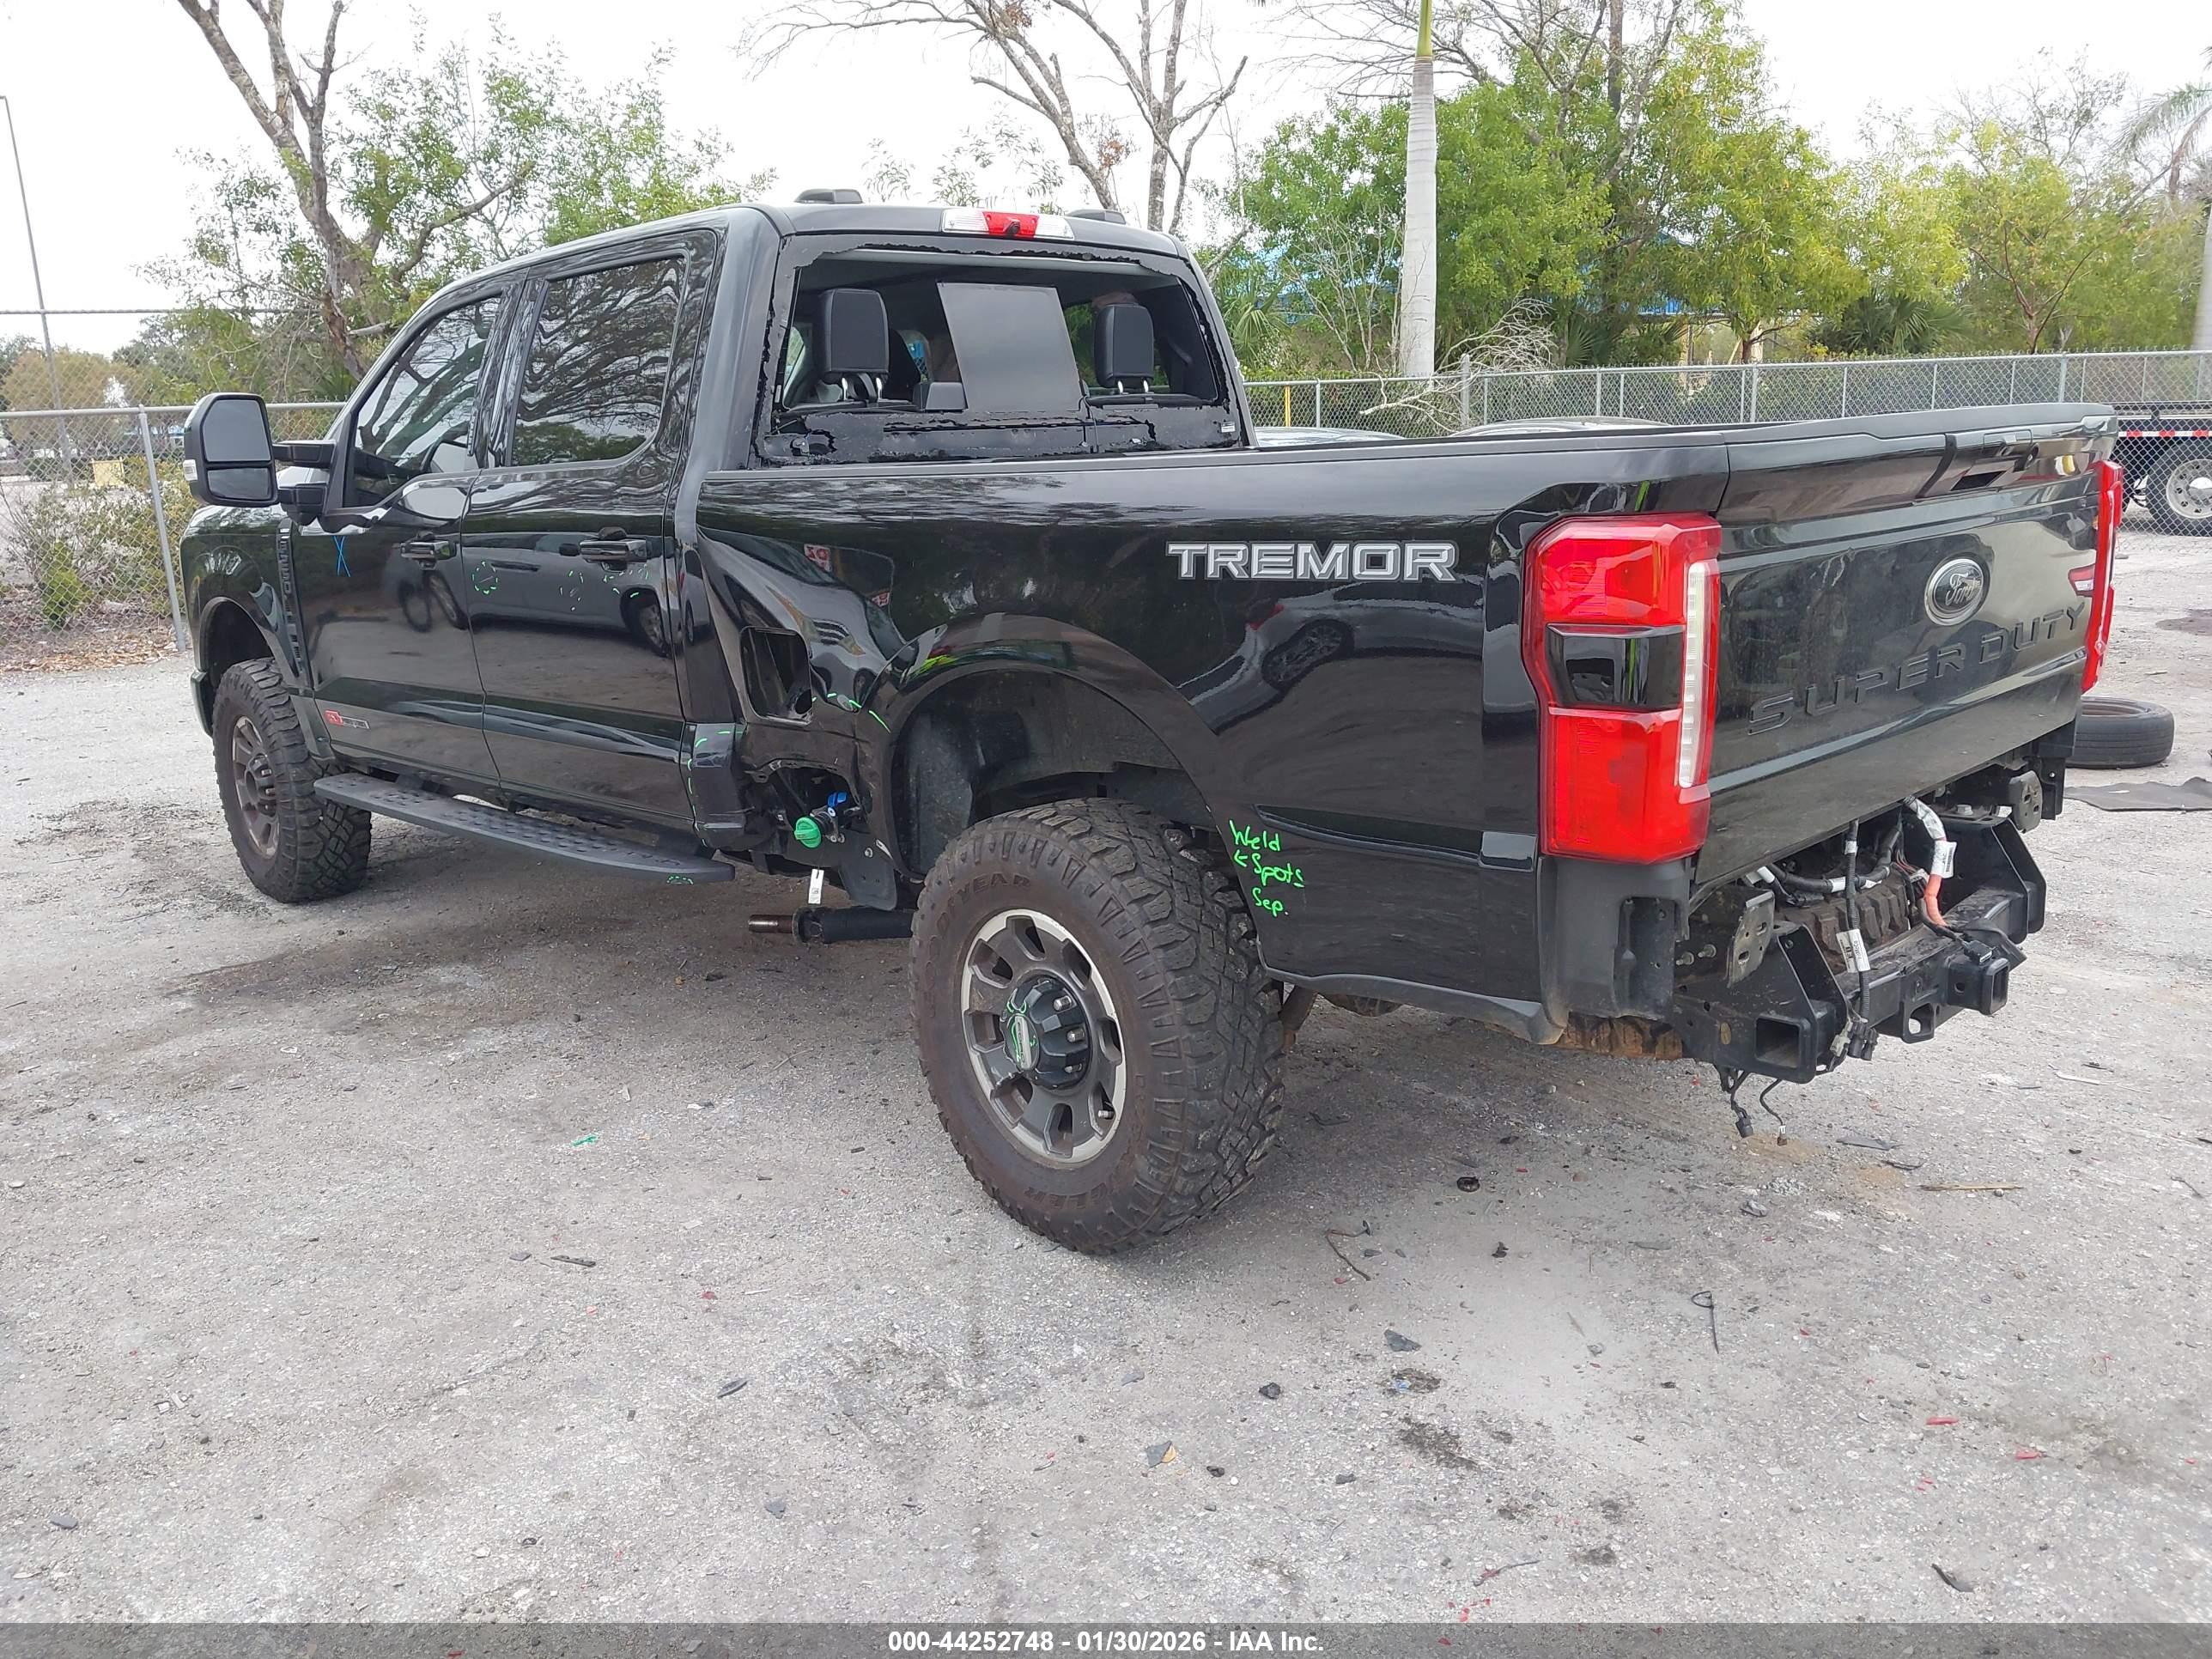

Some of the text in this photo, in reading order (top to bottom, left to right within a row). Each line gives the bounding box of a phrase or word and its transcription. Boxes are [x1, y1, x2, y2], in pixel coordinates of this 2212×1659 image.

[1167, 541, 1460, 582] TREMOR
[1945, 573, 1981, 606] Ford
[1748, 603, 2085, 736] SUPER DUTY
[1229, 819, 1281, 852] Weld
[1251, 853, 1305, 888] Spots
[1252, 887, 1289, 917] Sep.
